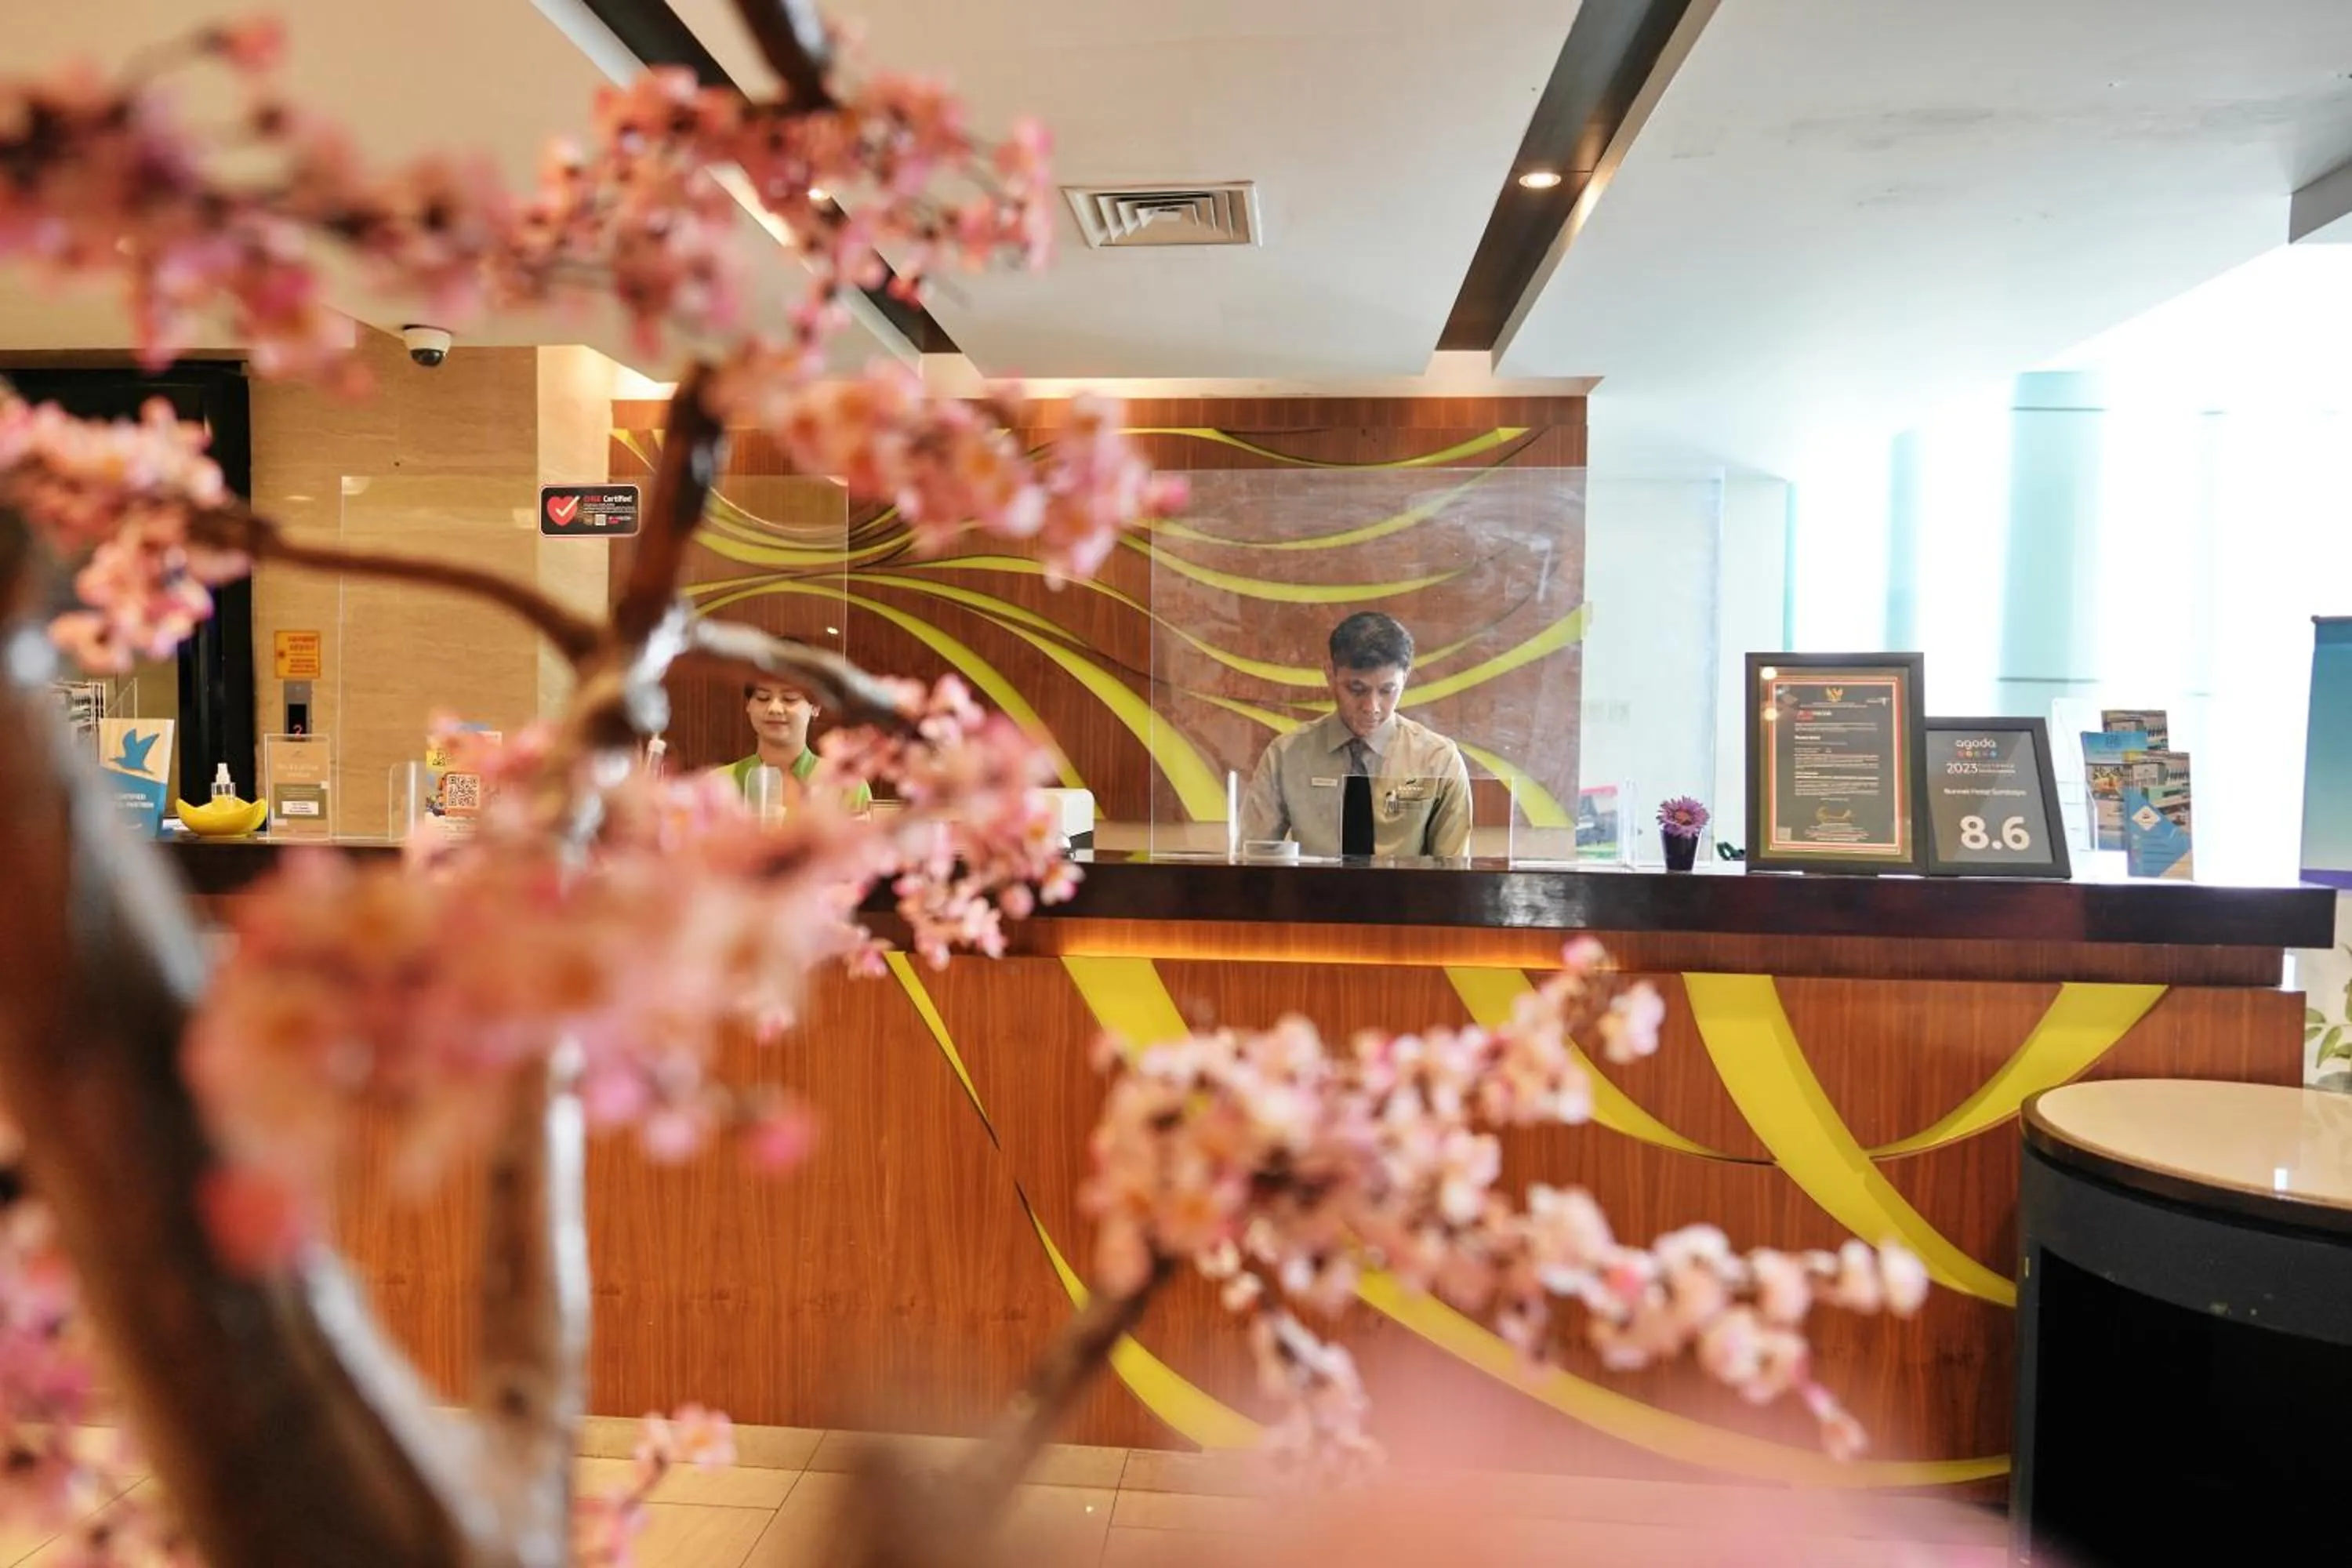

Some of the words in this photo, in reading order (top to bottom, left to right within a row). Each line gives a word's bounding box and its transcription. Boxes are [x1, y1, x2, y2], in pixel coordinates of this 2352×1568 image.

[1955, 737, 1997, 750] agoda
[1946, 763, 1978, 774] 2023
[1960, 815, 2030, 851] 8.6
